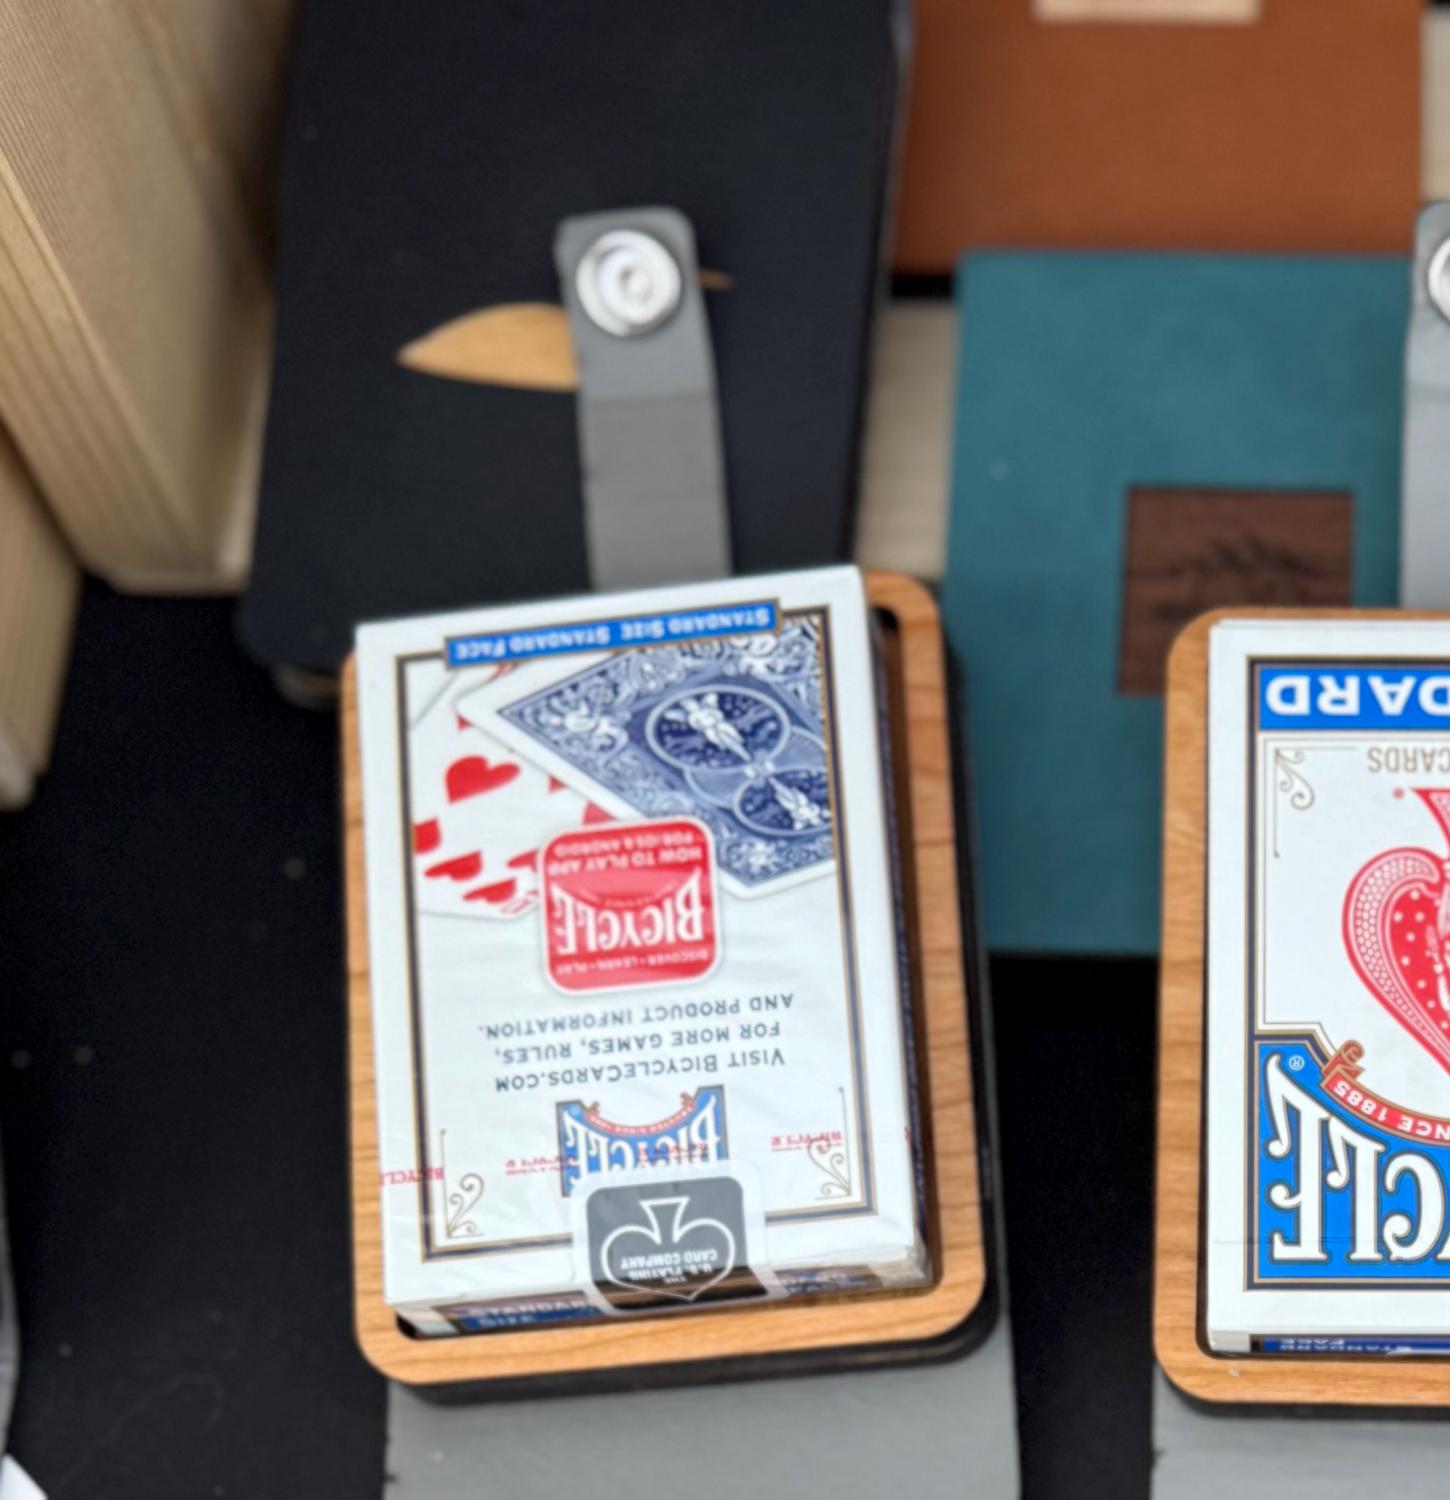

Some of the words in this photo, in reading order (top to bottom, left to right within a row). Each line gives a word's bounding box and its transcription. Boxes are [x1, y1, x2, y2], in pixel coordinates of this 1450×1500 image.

[551, 866, 705, 955] BICYCLE
[641, 998, 740, 1024] PRODUCT
[750, 993, 794, 1012] AND
[478, 1010, 632, 1040] INFORMATION.
[672, 1026, 730, 1047] MORE
[740, 1021, 781, 1041] FOR
[494, 1042, 572, 1065] RULES,
[580, 1033, 663, 1056] GAMES,
[1333, 1079, 1388, 1122] 1885
[562, 1094, 721, 1186] BICYCLE
[621, 1252, 681, 1270] COMPANY
[683, 1249, 718, 1264] CARD
